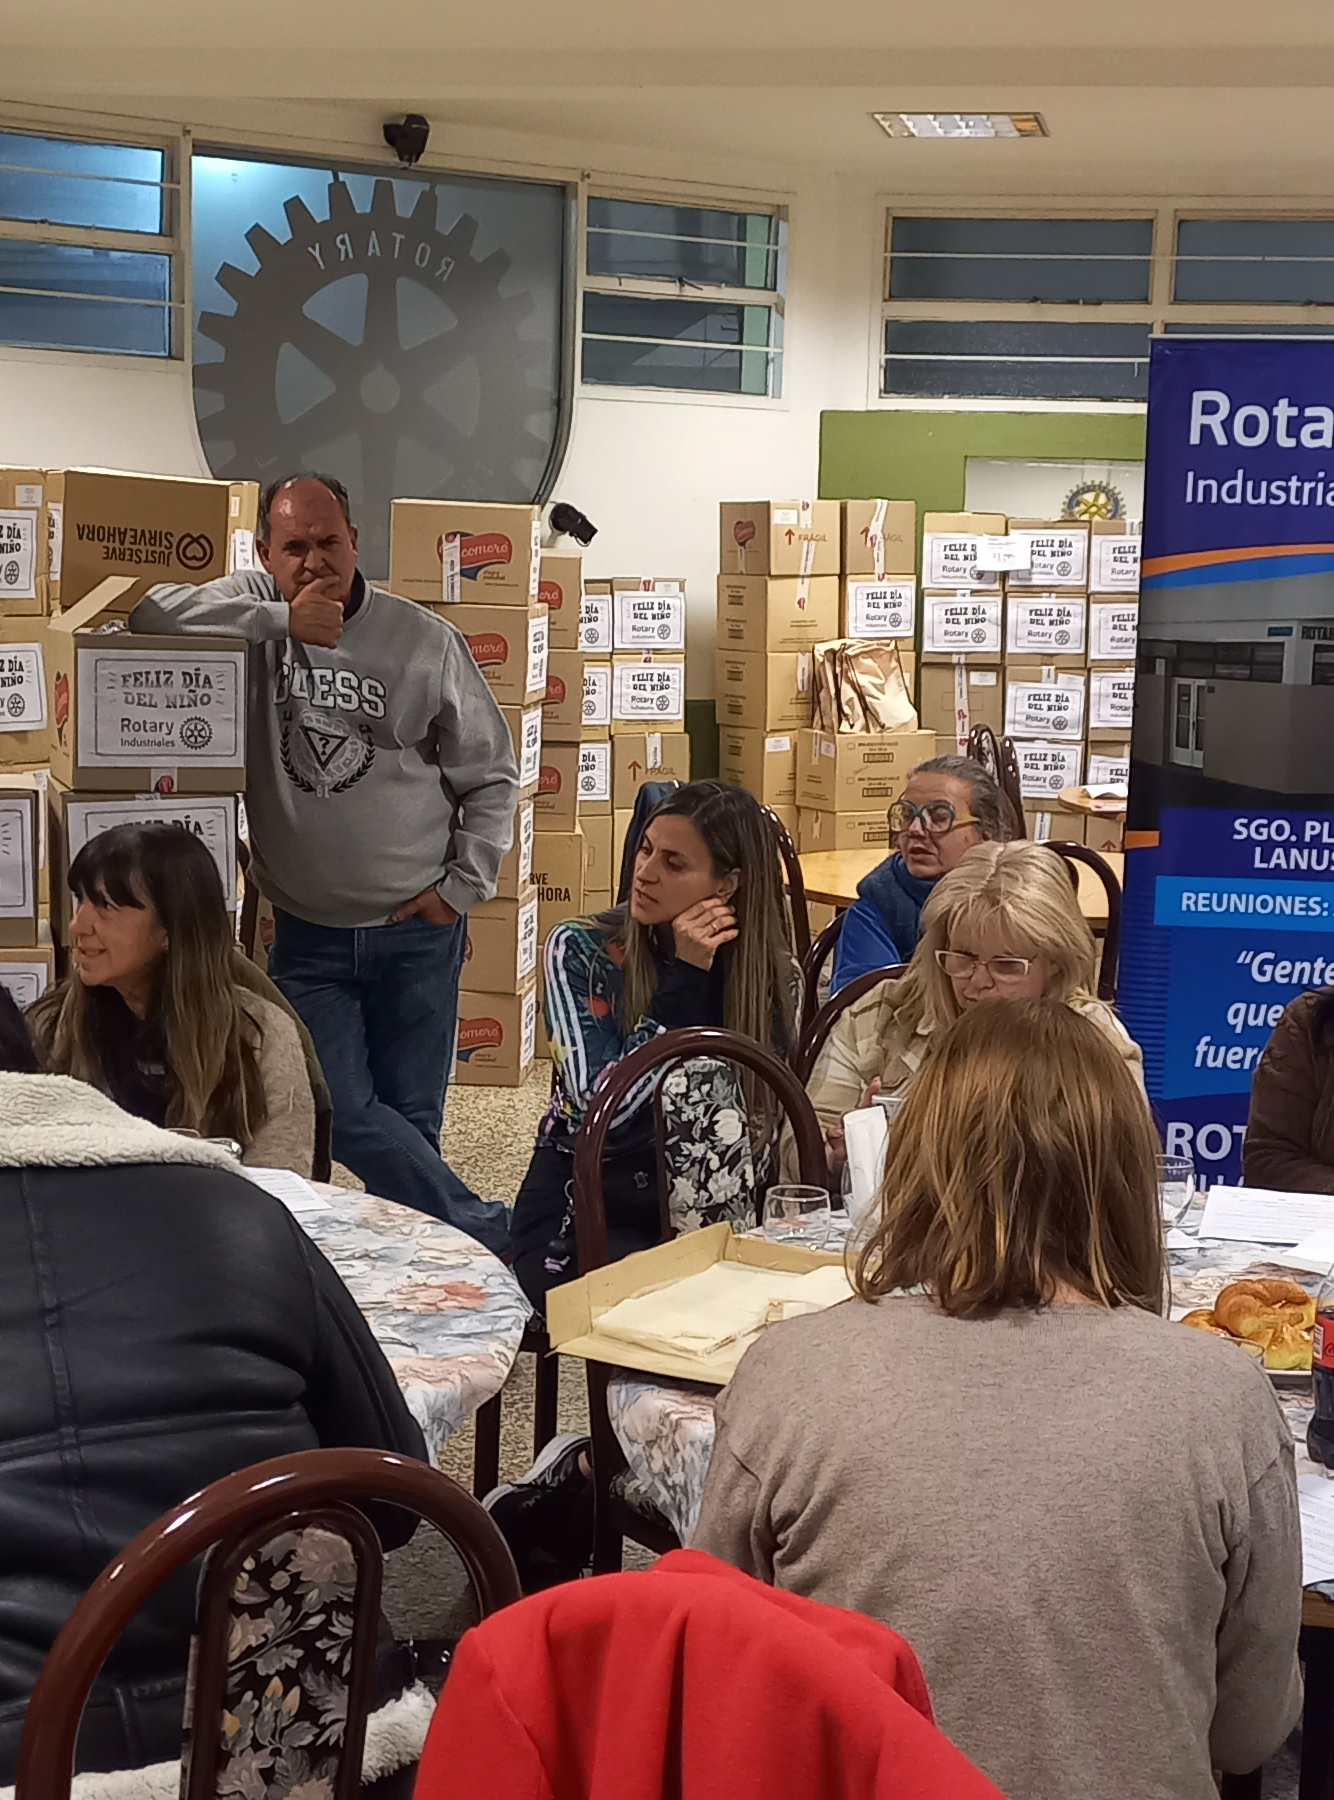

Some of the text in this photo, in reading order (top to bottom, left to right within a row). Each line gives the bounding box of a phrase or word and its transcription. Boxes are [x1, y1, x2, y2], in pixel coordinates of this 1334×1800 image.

[0, 539, 21, 554] NIÑO
[1031, 539, 1055, 548] FELIZ
[1031, 549, 1047, 557] DEL
[632, 602, 654, 611] FELIZ
[944, 607, 968, 616] FELIZ
[633, 612, 648, 620] DEL
[0, 673, 24, 688] NIÑO
[121, 671, 174, 688] FELIZ
[123, 689, 212, 709] DEL NIÑO
[1027, 693, 1052, 702] FELIZ
[1027, 703, 1044, 711] DEL
[121, 718, 175, 735] Rotary
[121, 738, 175, 748] Industriales
[1233, 819, 1296, 843] SGO.
[1181, 892, 1329, 917] REUNIONES:
[1227, 1002, 1284, 1033] que
[1194, 1036, 1264, 1069] fuer
